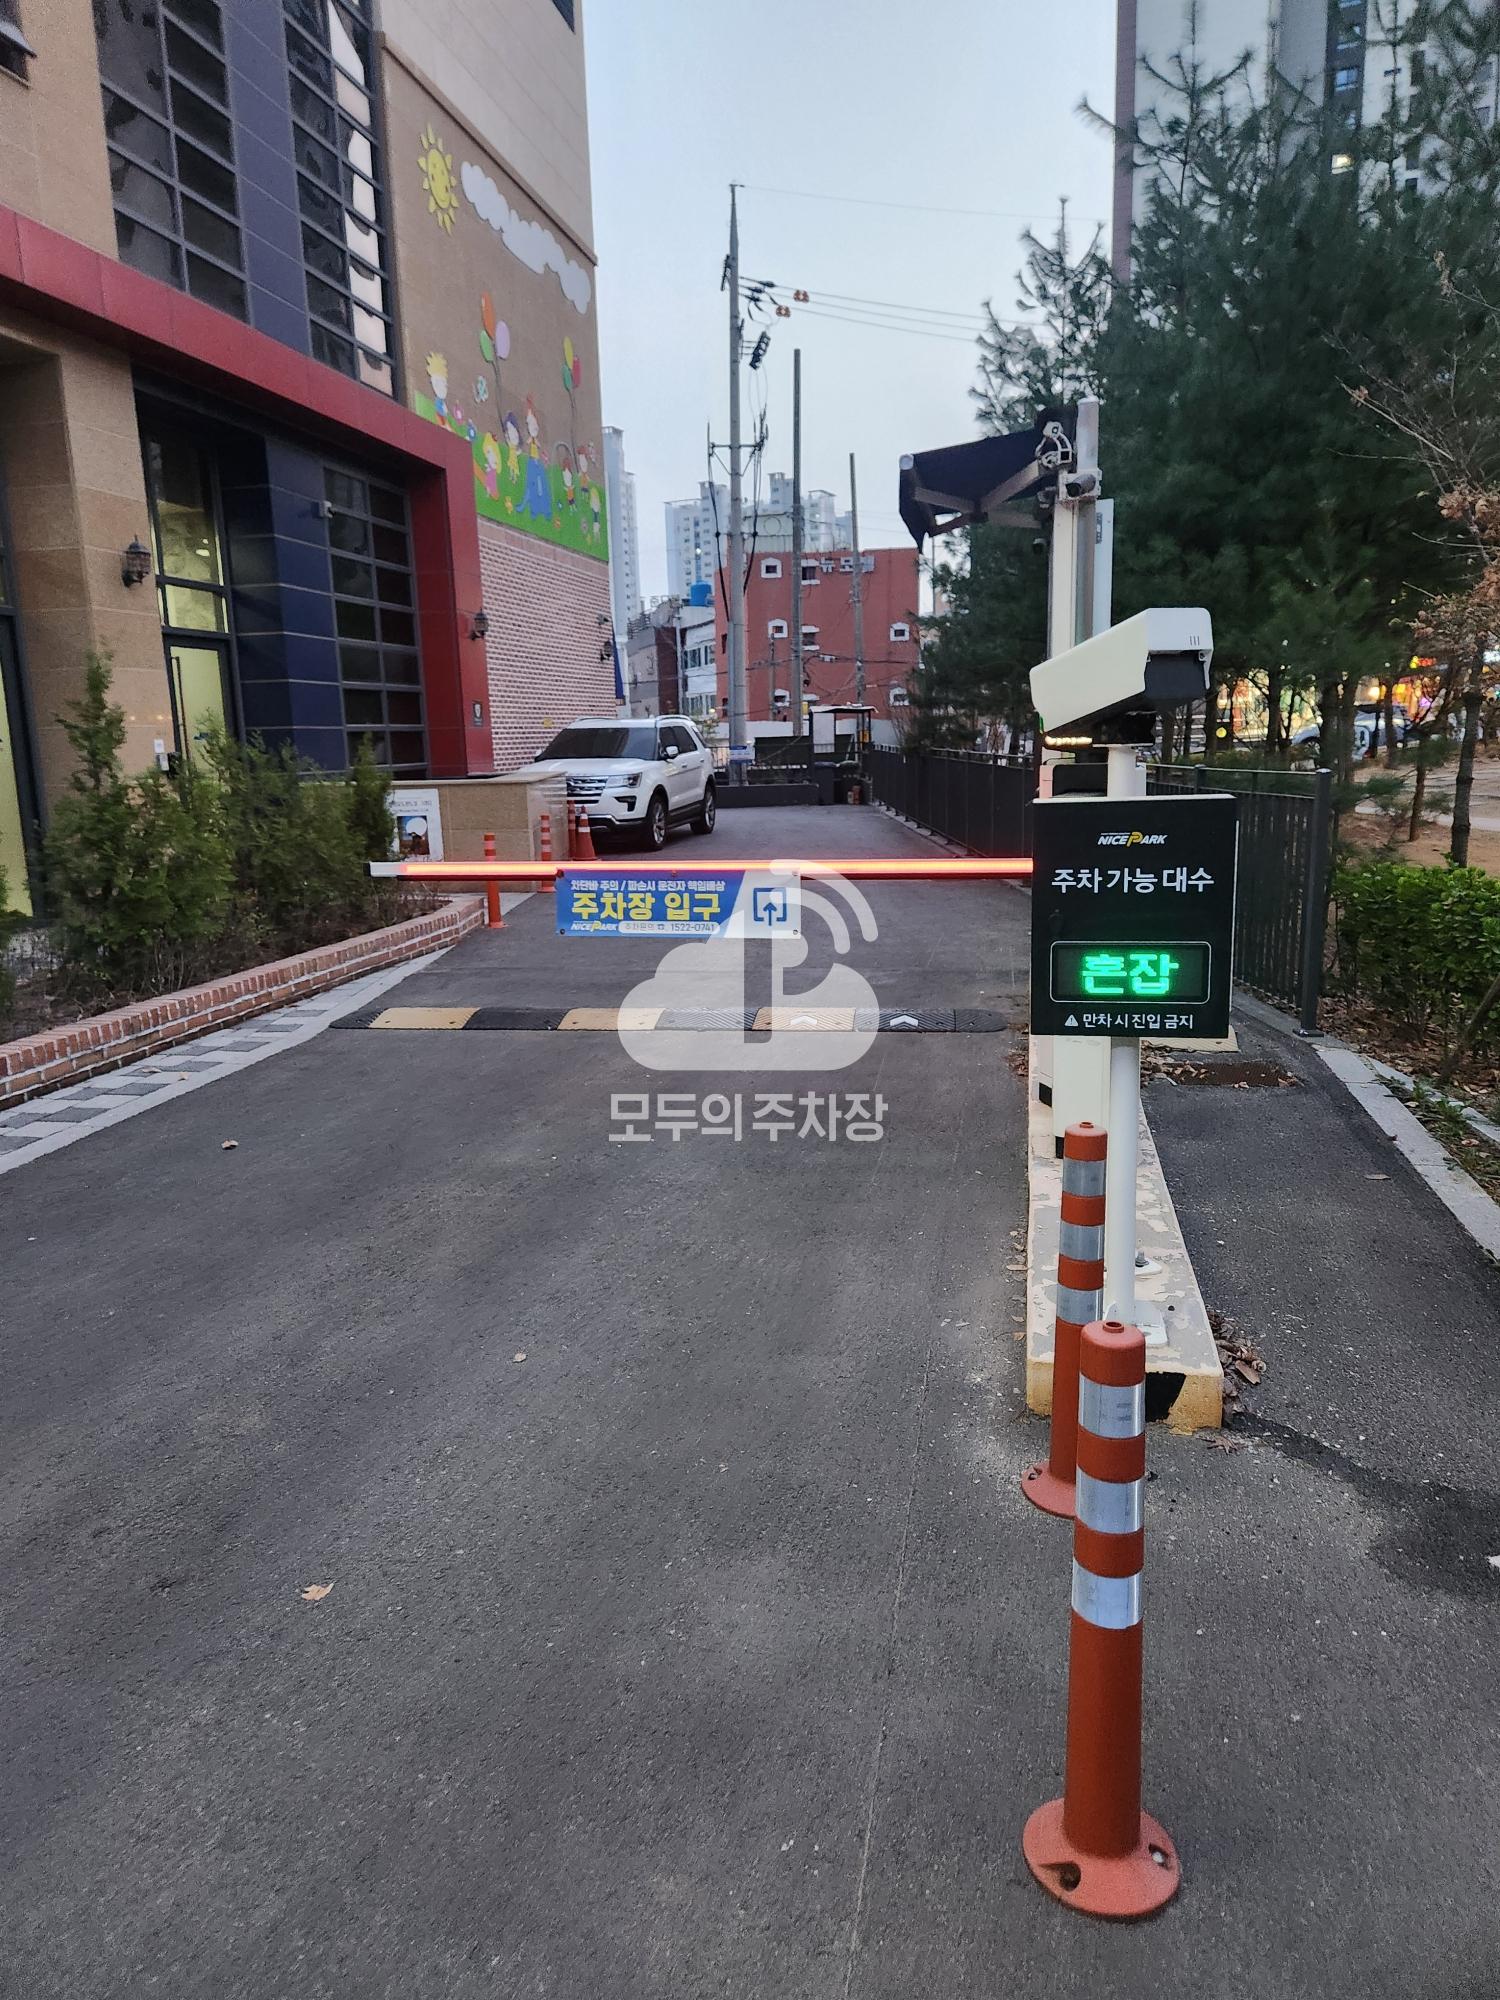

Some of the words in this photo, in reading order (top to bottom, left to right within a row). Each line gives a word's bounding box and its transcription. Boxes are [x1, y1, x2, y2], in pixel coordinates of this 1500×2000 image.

[1097, 831, 1168, 847] NICEPARK
[601, 880, 619, 891] 주의
[628, 880, 656, 891] 파손시
[658, 880, 686, 891] 운전자
[688, 880, 725, 892] 책임배상
[1051, 867, 1102, 893] 주차
[1107, 867, 1158, 893] 가능
[1163, 866, 1214, 893] 대수
[572, 892, 656, 920] 주차장
[664, 892, 721, 921] 입구
[671, 921, 715, 932] 1522-0741
[1081, 952, 1179, 995] 혼잡
[1083, 1013, 1112, 1029] 만차
[1115, 1013, 1129, 1029] 시
[1131, 1014, 1161, 1029] 진입
[1164, 1014, 1194, 1029] 금지
